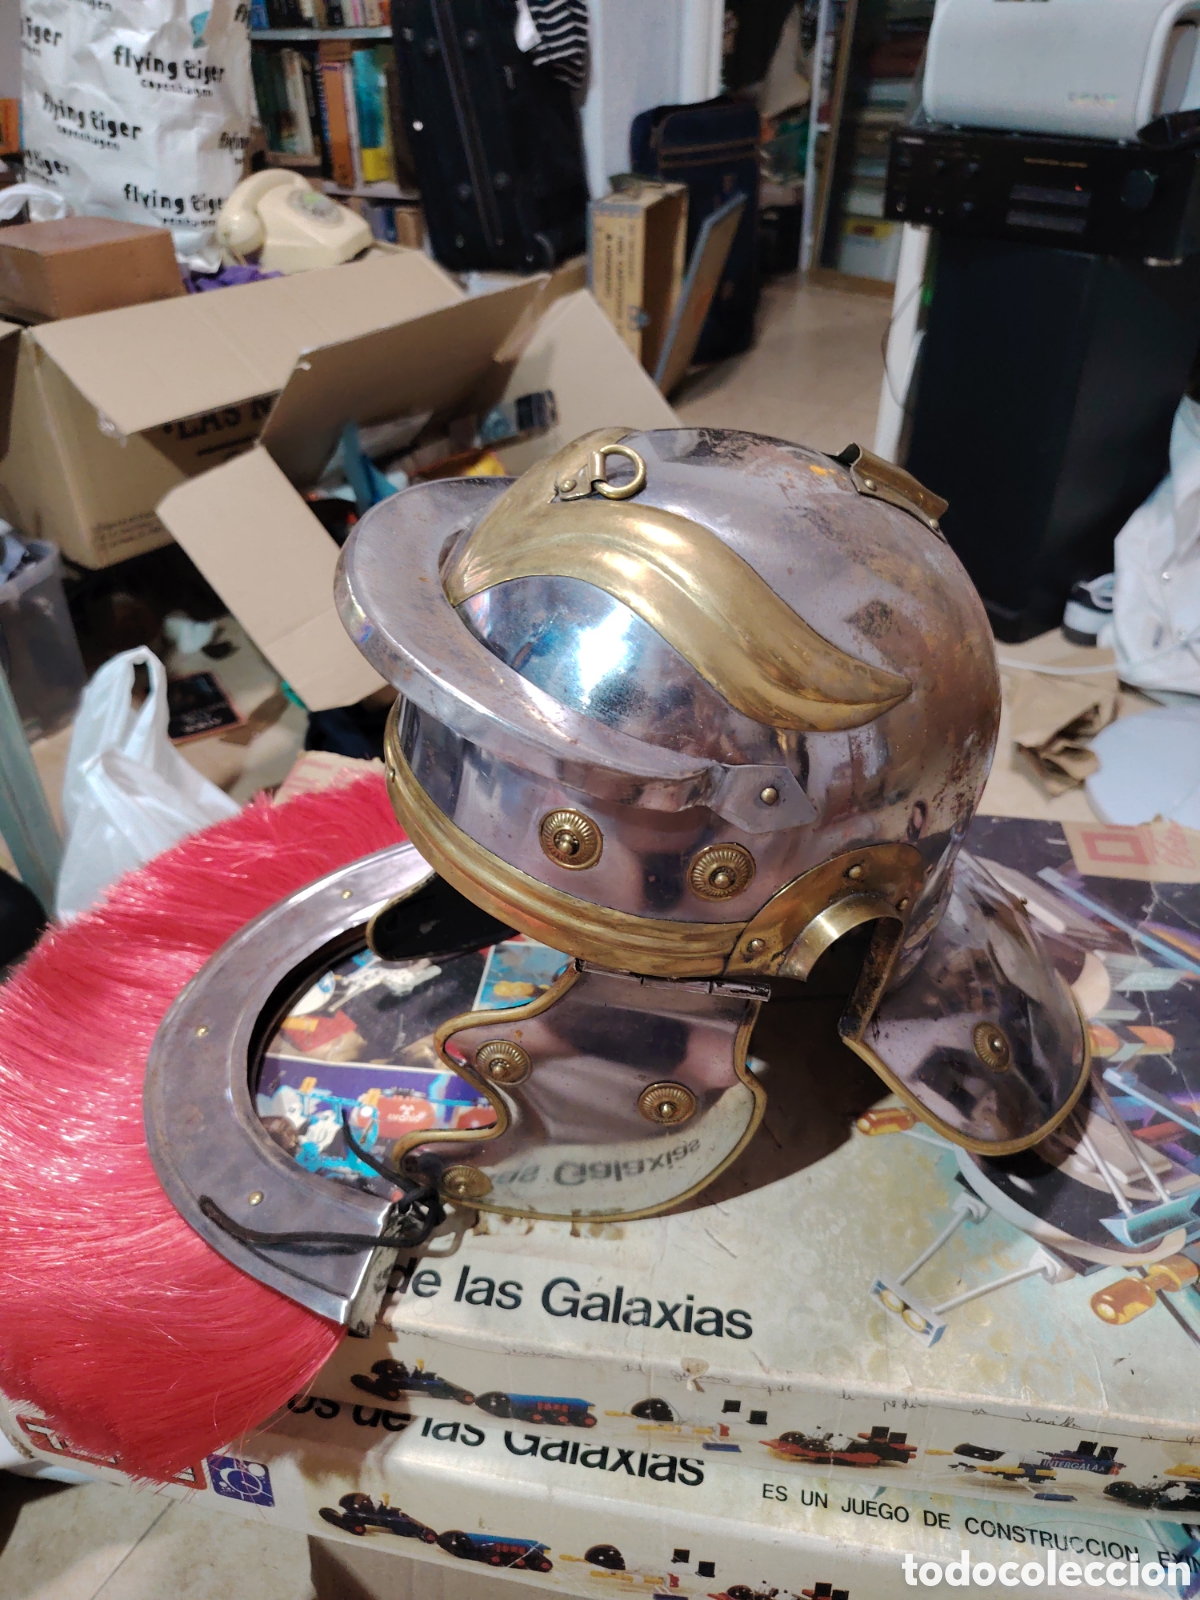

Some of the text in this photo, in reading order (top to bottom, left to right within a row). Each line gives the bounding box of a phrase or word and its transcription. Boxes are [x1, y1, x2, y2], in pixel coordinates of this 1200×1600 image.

[113, 45, 225, 85] flying tiger
[90, 109, 143, 139] tiger
[123, 183, 185, 215] flying
[387, 1257, 753, 1340] de las Galaxias
[504, 1430, 705, 1487] Galaxias
[762, 1483, 788, 1502] ES
[801, 1489, 828, 1508] UN
[841, 1497, 910, 1523] JUEGO
[923, 1510, 951, 1530] DE
[964, 1516, 1140, 1564] CONSTRUCCION
